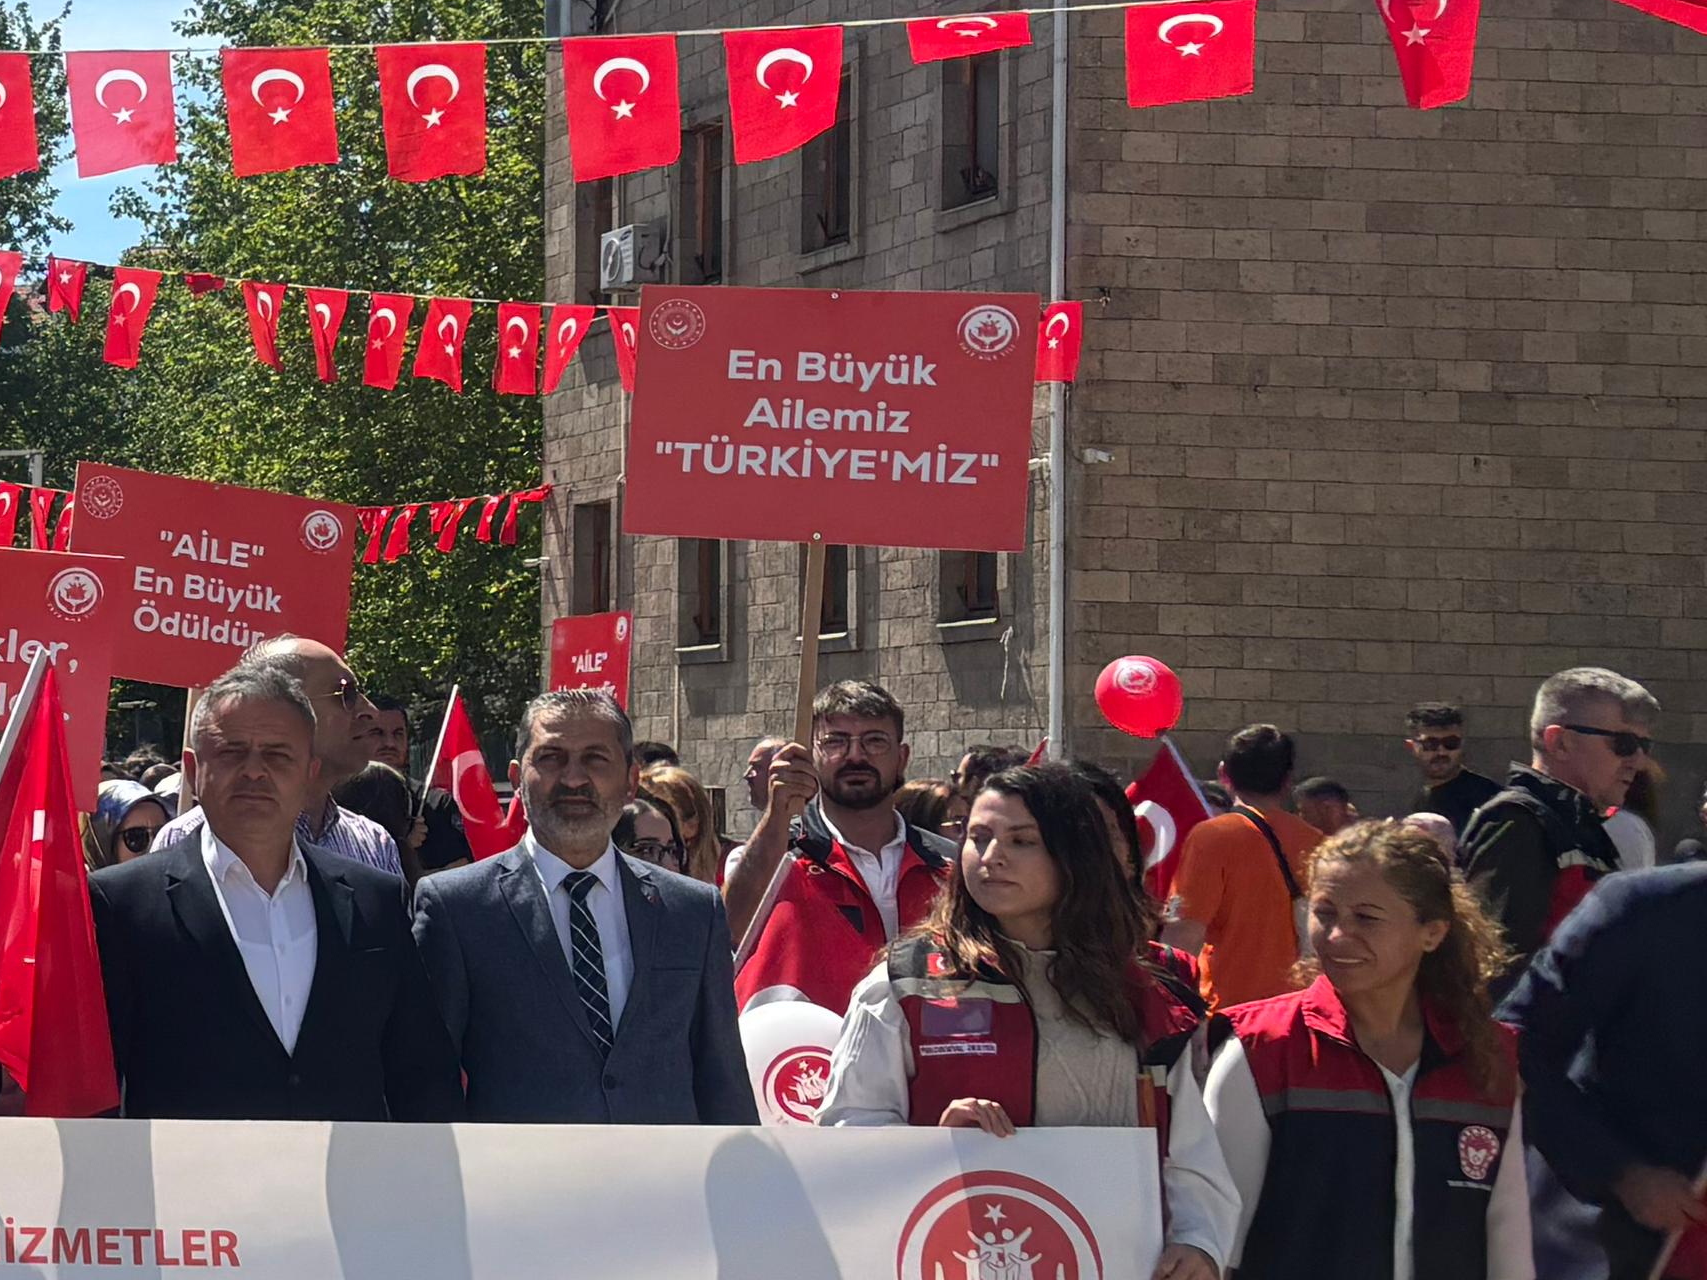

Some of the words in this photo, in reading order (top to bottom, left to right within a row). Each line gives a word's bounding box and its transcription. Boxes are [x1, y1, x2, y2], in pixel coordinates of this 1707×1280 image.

[728, 349, 782, 381] En
[797, 352, 937, 392] Büyük
[743, 398, 910, 433] Ailemiz
[655, 435, 999, 485] "TÜRKİYE'MİZ"
[160, 529, 265, 568] "AİLE"
[133, 566, 174, 596] En
[184, 574, 282, 614] Büyük
